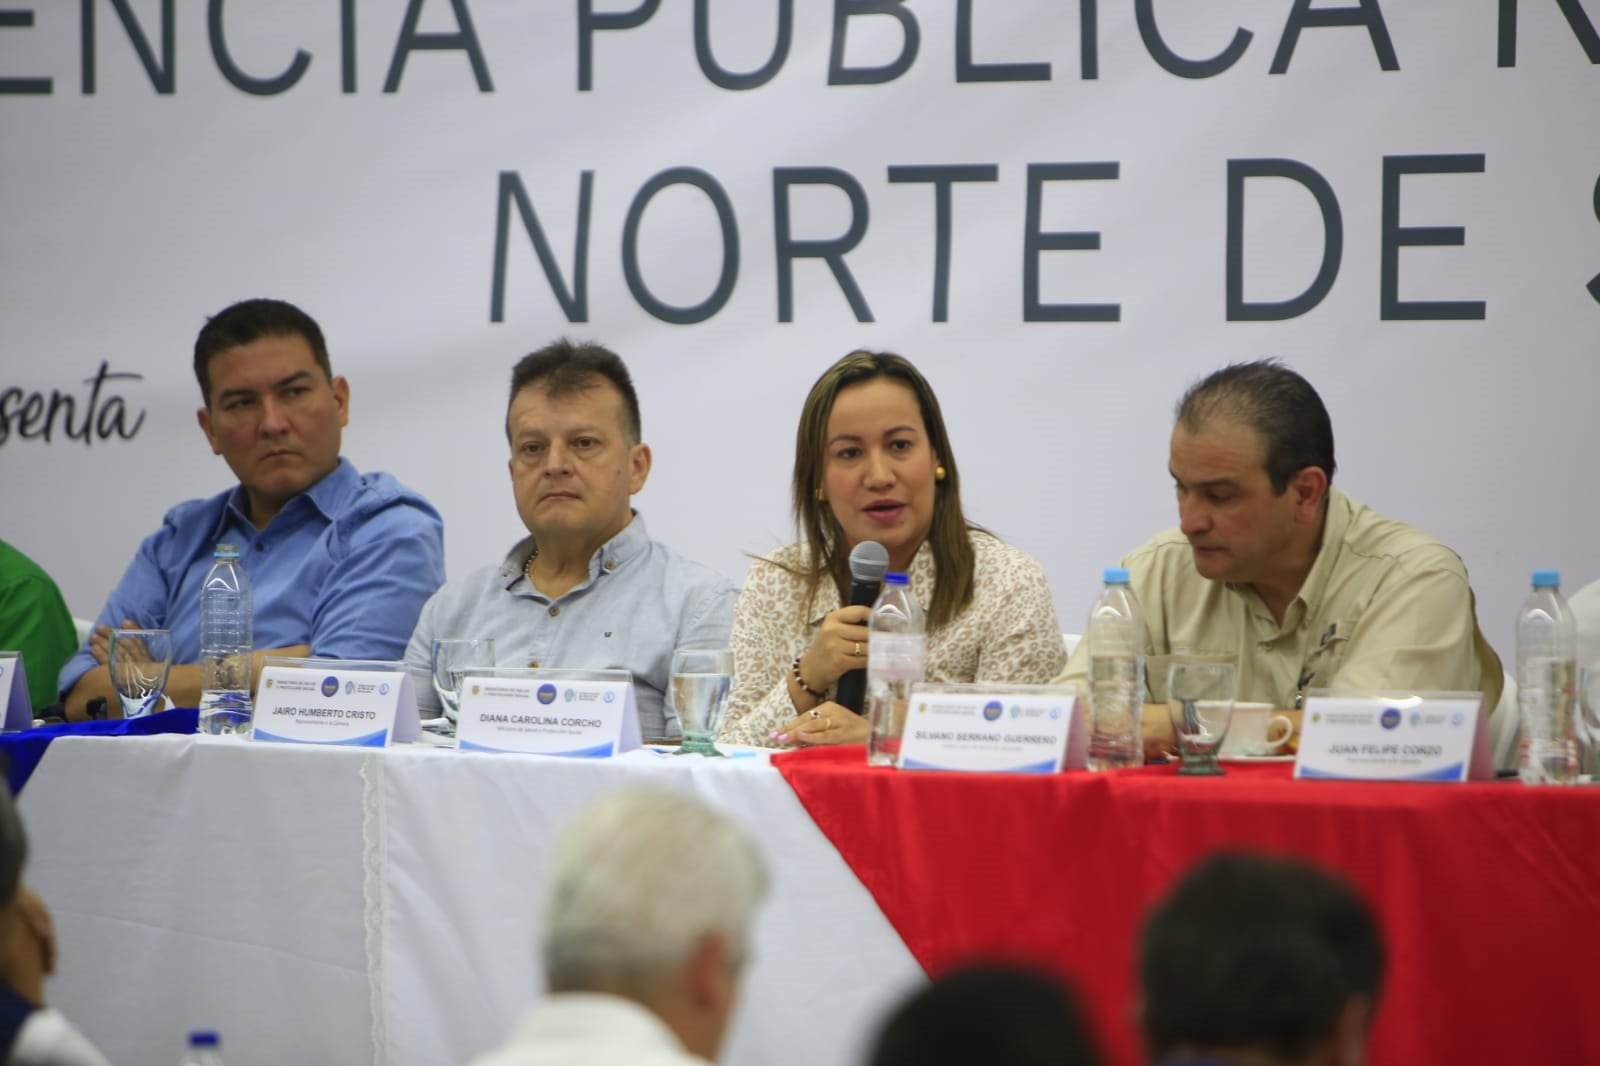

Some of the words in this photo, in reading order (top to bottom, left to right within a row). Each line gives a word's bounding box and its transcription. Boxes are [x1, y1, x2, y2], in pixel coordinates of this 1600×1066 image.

[489, 161, 1121, 325] NORTE
[1225, 153, 1487, 322] DE
[272, 706, 297, 717] JAIRO
[298, 708, 345, 719] HUMBERTO
[345, 710, 377, 721] CRISTO
[479, 713, 509, 724] DIANA
[510, 714, 559, 727] CAROLINA
[560, 717, 603, 729] CORCHO
[915, 731, 954, 742] SILVANO
[956, 732, 1002, 743] SERRANO
[1003, 734, 1058, 745] GUERRERO
[1329, 743, 1359, 755] JUAN
[1361, 743, 1400, 756] FELIPE
